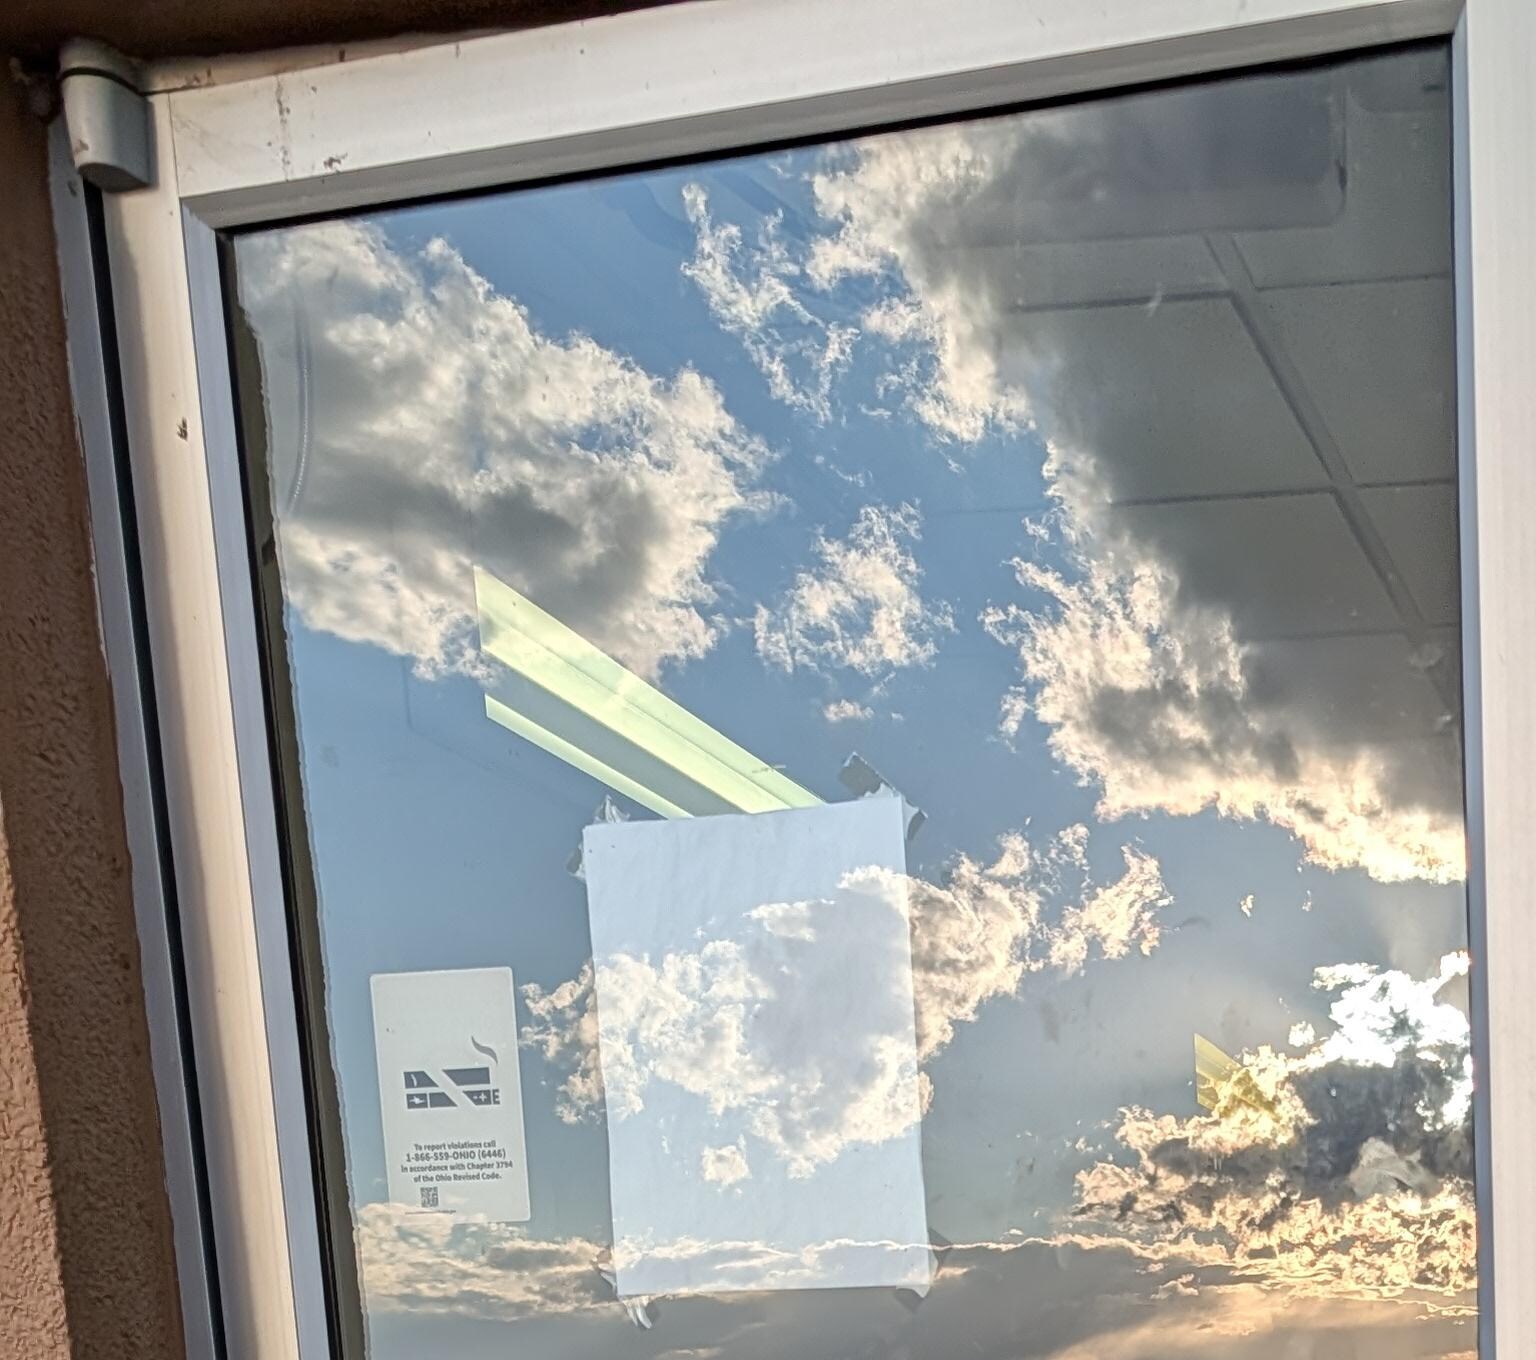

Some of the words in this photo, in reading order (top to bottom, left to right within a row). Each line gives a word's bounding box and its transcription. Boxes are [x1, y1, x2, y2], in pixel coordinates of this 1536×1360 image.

[424, 1143, 446, 1152] report
[483, 1140, 496, 1148] call
[406, 1150, 476, 1162] 1-866-559-OHIO
[478, 1148, 506, 1160] (6446)
[409, 1164, 448, 1173] accordance
[449, 1163, 466, 1171] with
[467, 1162, 494, 1171] Chapter
[413, 1175, 421, 1183] of
[435, 1174, 452, 1182] Ohio
[453, 1172, 480, 1181] Revised
